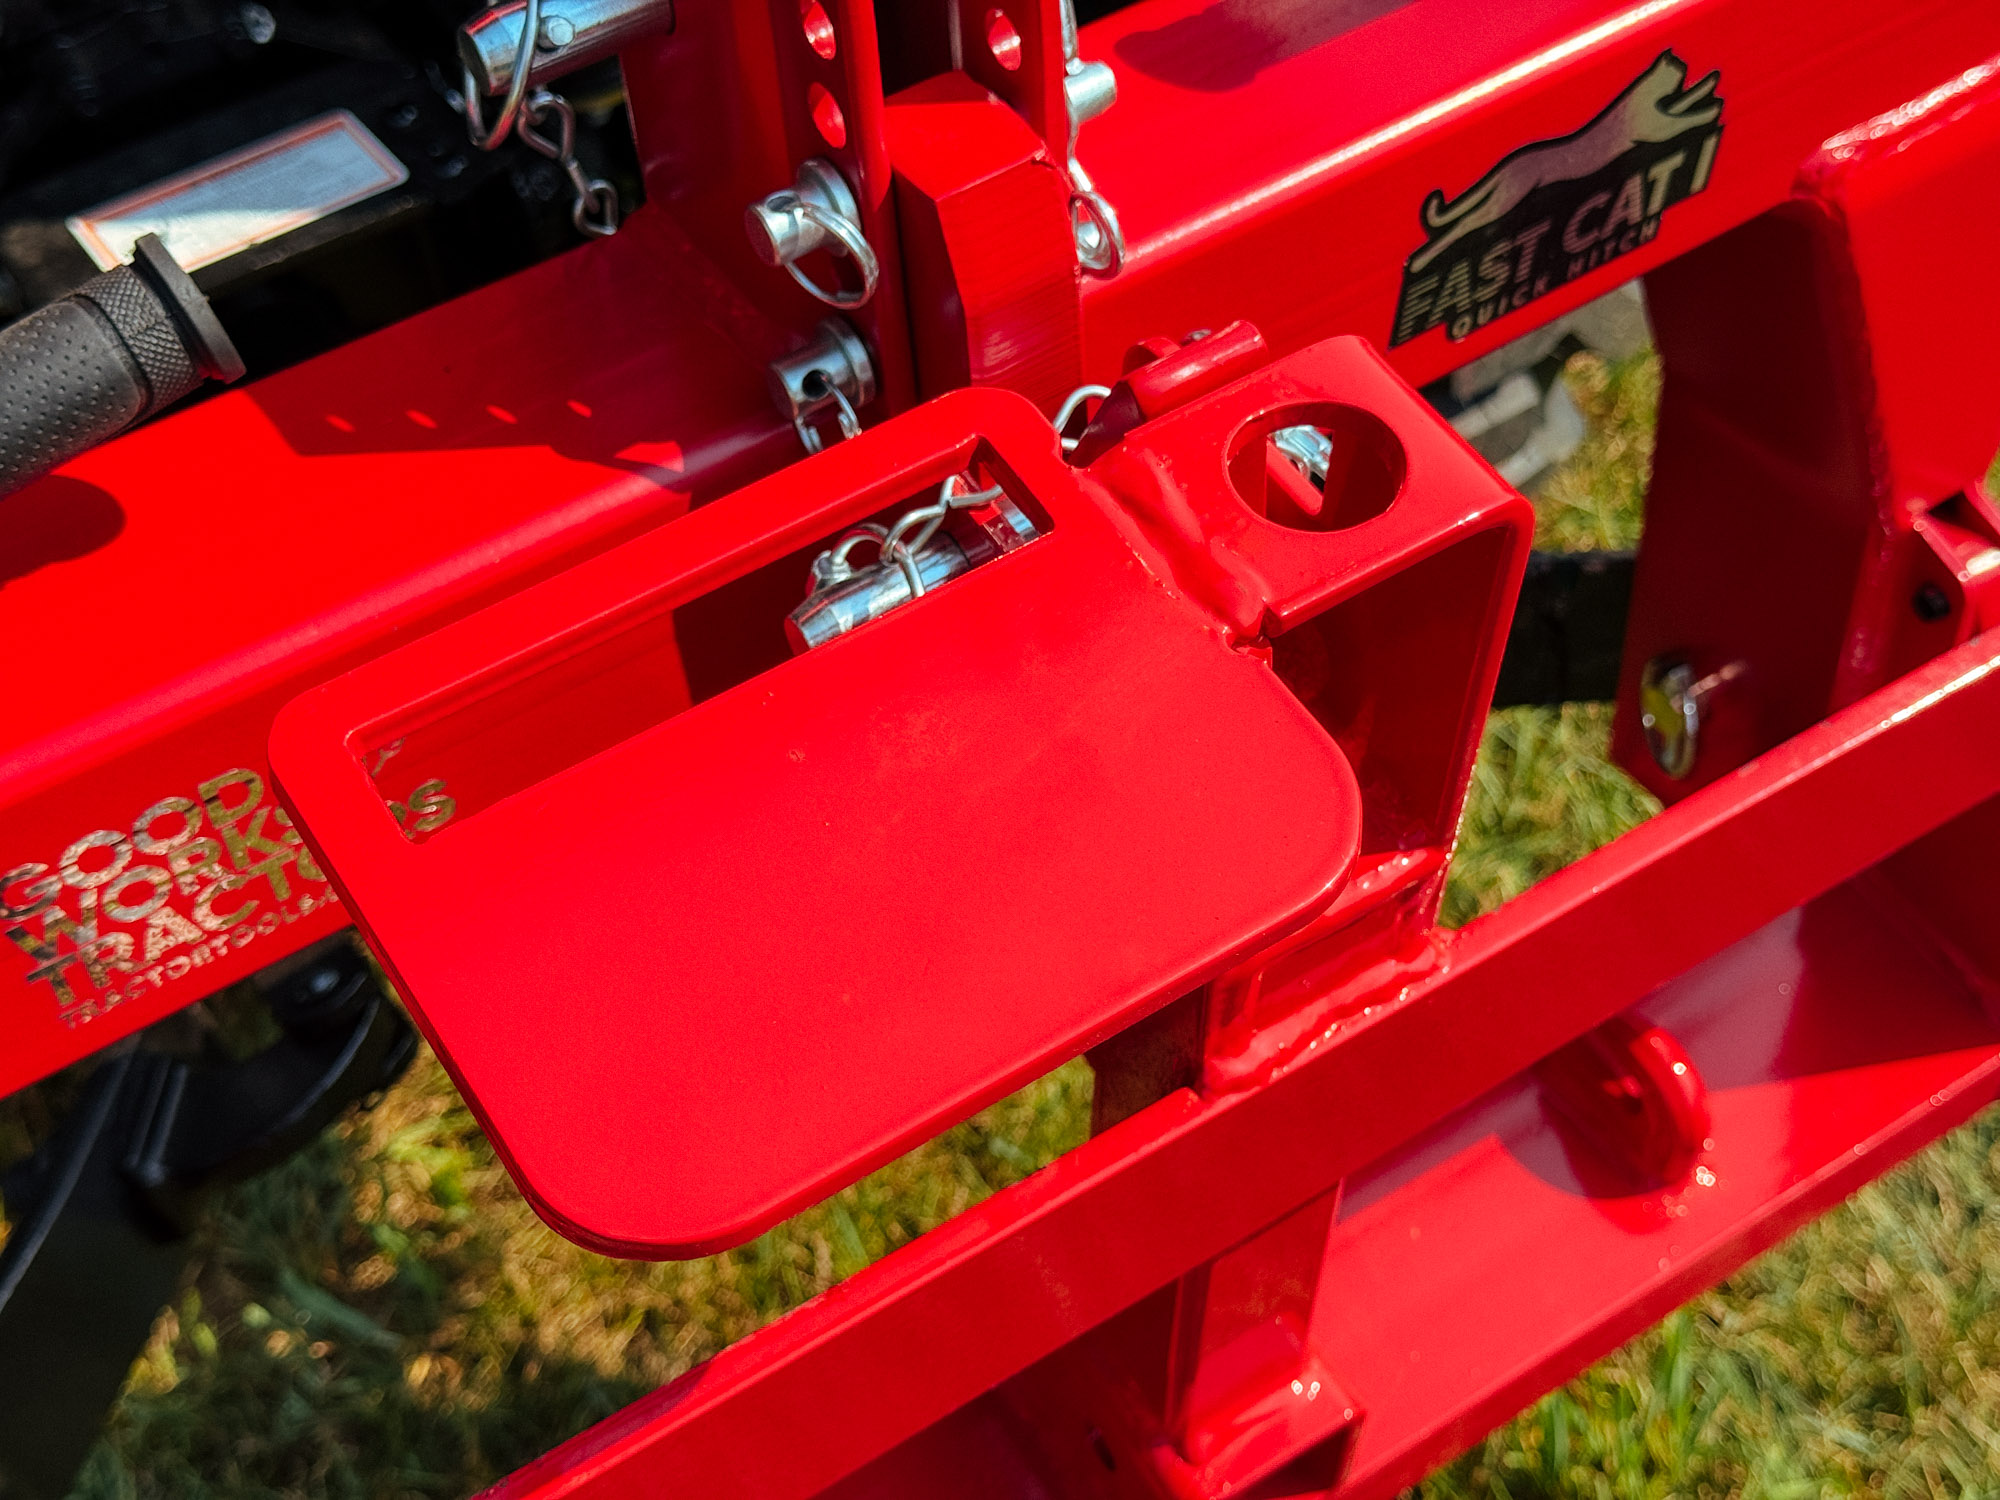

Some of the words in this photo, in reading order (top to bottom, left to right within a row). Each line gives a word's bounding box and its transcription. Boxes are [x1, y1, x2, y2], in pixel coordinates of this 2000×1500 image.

[1397, 219, 1551, 341] FAST
[1563, 151, 1687, 254] CAT
[1451, 276, 1551, 339] QUICK
[1565, 221, 1659, 281] HITCH
[0, 768, 264, 922] GOOD
